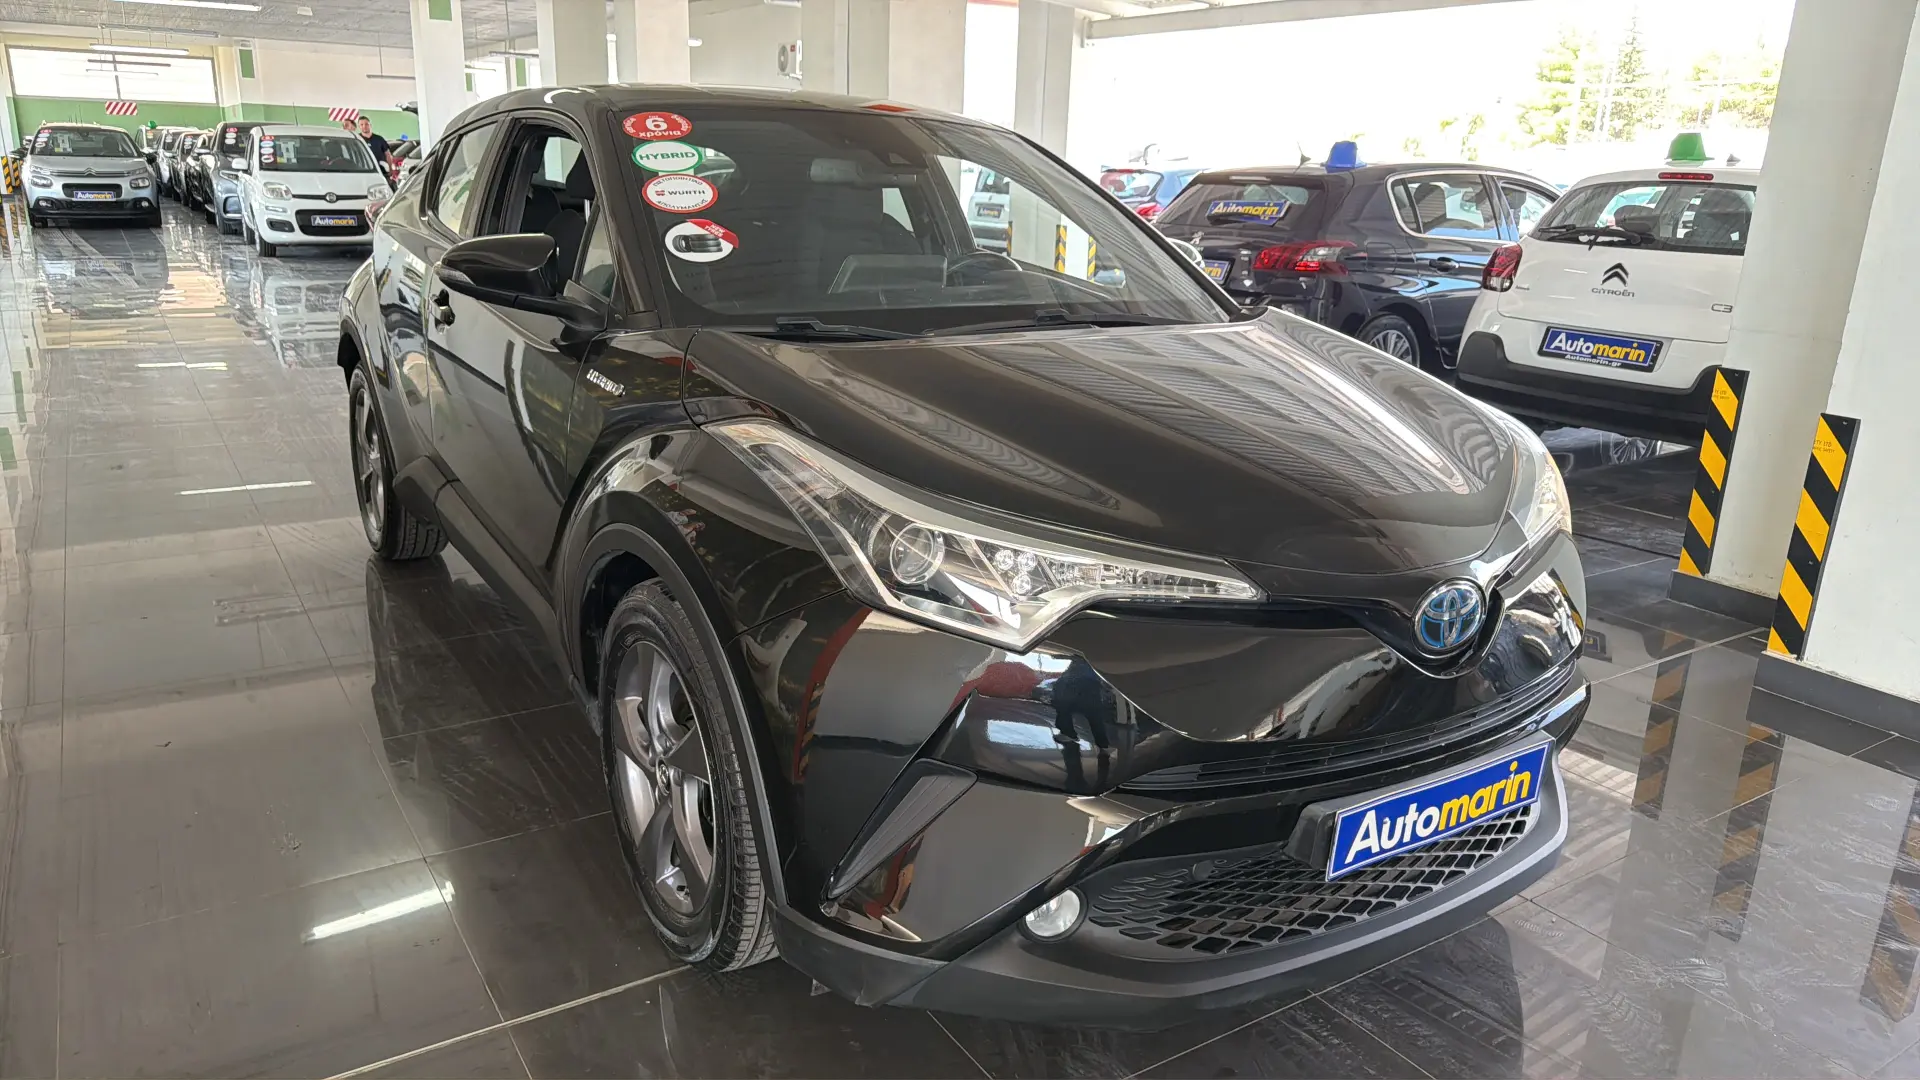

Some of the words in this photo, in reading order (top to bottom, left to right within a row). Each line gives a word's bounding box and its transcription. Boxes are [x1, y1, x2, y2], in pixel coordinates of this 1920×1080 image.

[645, 117, 668, 131] 6
[638, 130, 681, 138] χρόνια
[638, 151, 696, 161] HYBRID
[77, 191, 112, 199] Automarin
[314, 216, 355, 225] Automarin
[1711, 303, 1733, 313] C3
[1550, 332, 1646, 362] Automarin
[1564, 353, 1622, 367] Automarin.gr
[1344, 760, 1532, 865] Automarin
